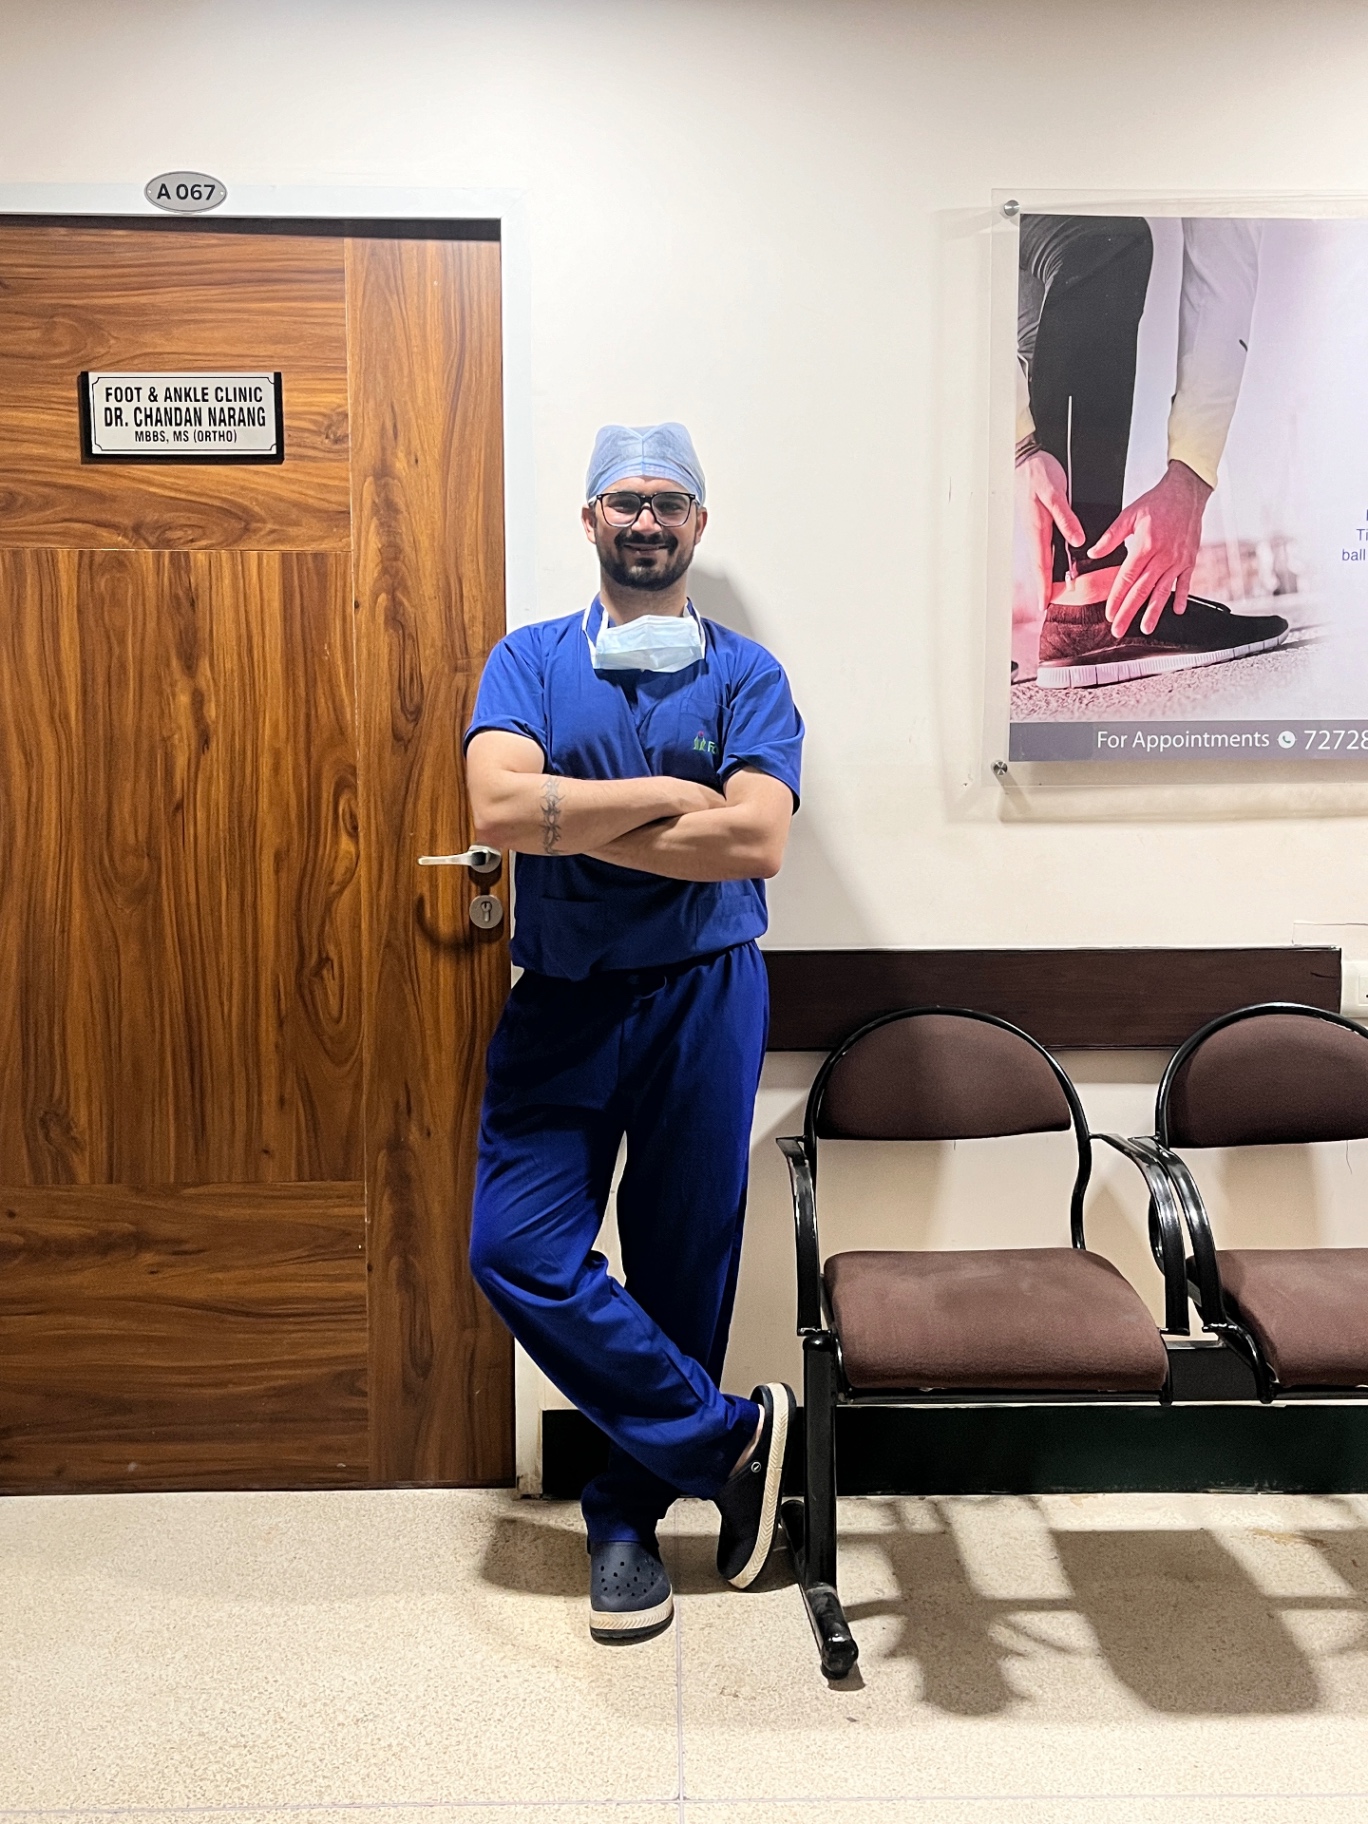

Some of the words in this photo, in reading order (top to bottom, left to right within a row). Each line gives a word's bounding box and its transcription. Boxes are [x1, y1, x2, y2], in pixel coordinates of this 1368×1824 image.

[157, 183, 171, 200] A
[176, 183, 216, 201] 067
[105, 386, 143, 403] FOOT
[147, 386, 159, 403] &
[163, 386, 209, 403] ANKLE
[214, 386, 263, 403] CLINIC
[104, 406, 129, 427] DR.
[133, 406, 203, 428] CHANDAN
[207, 406, 266, 427] NARANG
[134, 430, 169, 444] MBBS,
[173, 430, 189, 442] MS
[193, 429, 237, 443] (ORTHO)
[1341, 548, 1366, 561] ball
[1097, 730, 1128, 749] For
[1132, 730, 1270, 753] Appointments
